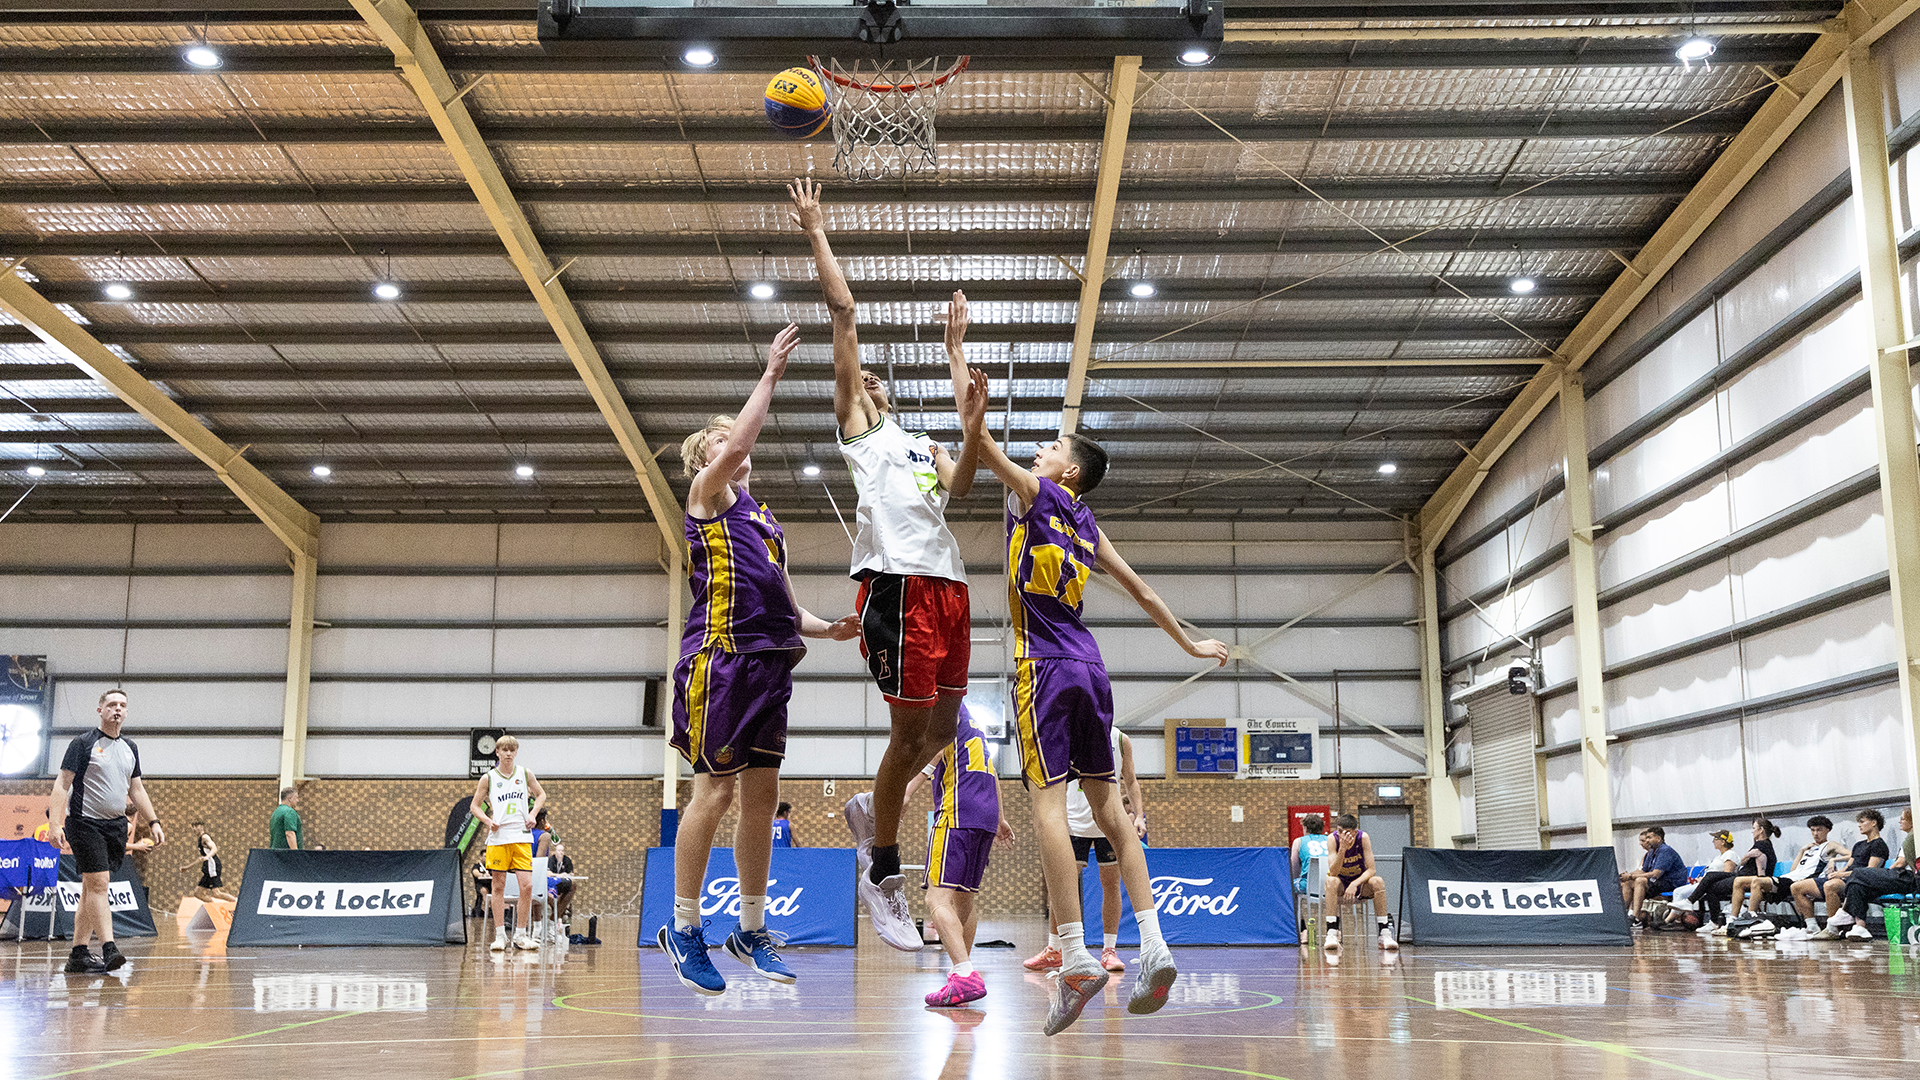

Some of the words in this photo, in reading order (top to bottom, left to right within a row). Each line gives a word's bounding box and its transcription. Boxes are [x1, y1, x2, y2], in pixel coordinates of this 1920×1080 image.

[1246, 718, 1262, 729] The
[1265, 718, 1297, 729] Courier
[1266, 764, 1298, 775] Courier
[497, 790, 524, 803] MAGIC
[825, 784, 834, 795] 6
[506, 803, 516, 815] 6
[108, 887, 131, 906] cker
[266, 887, 325, 910] Foot
[335, 888, 425, 911] Locker
[700, 877, 804, 917] Fod
[1150, 876, 1240, 916] Ford
[1436, 886, 1494, 909] Foot
[1502, 887, 1593, 910] Locker
